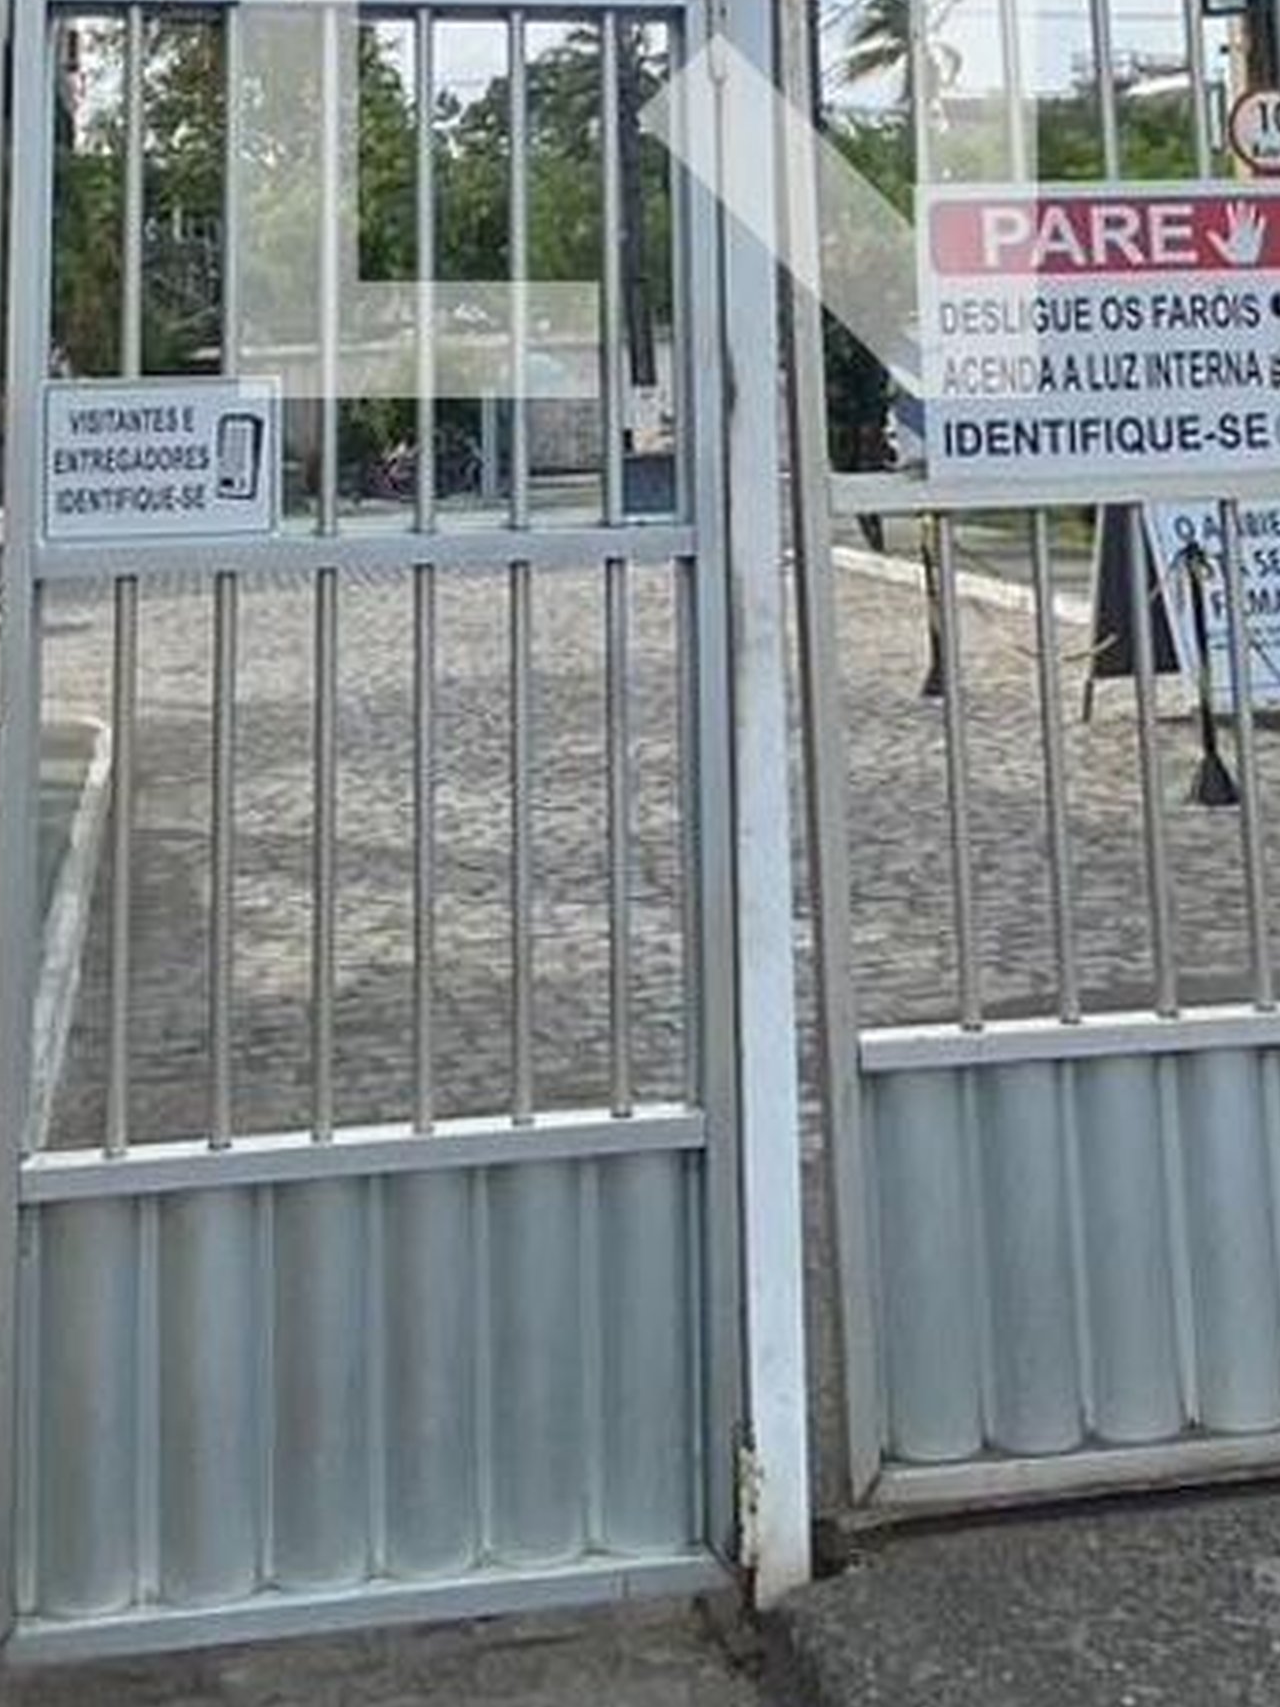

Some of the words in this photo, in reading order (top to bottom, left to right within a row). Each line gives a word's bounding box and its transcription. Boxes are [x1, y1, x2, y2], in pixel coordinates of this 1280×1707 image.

[980, 203, 1199, 267] PARE
[941, 296, 1095, 336] DESLIGUE
[1100, 294, 1144, 332] OS
[942, 354, 1057, 395] ACENDA
[1061, 355, 1082, 392] A
[1088, 352, 1138, 390] LUZ
[1145, 349, 1265, 389] INTERNA
[69, 406, 178, 434] VISITANTES
[182, 405, 195, 433] E
[943, 410, 1272, 458] IDENTIFIQUE-SE
[54, 445, 210, 475] ENTREGADORES
